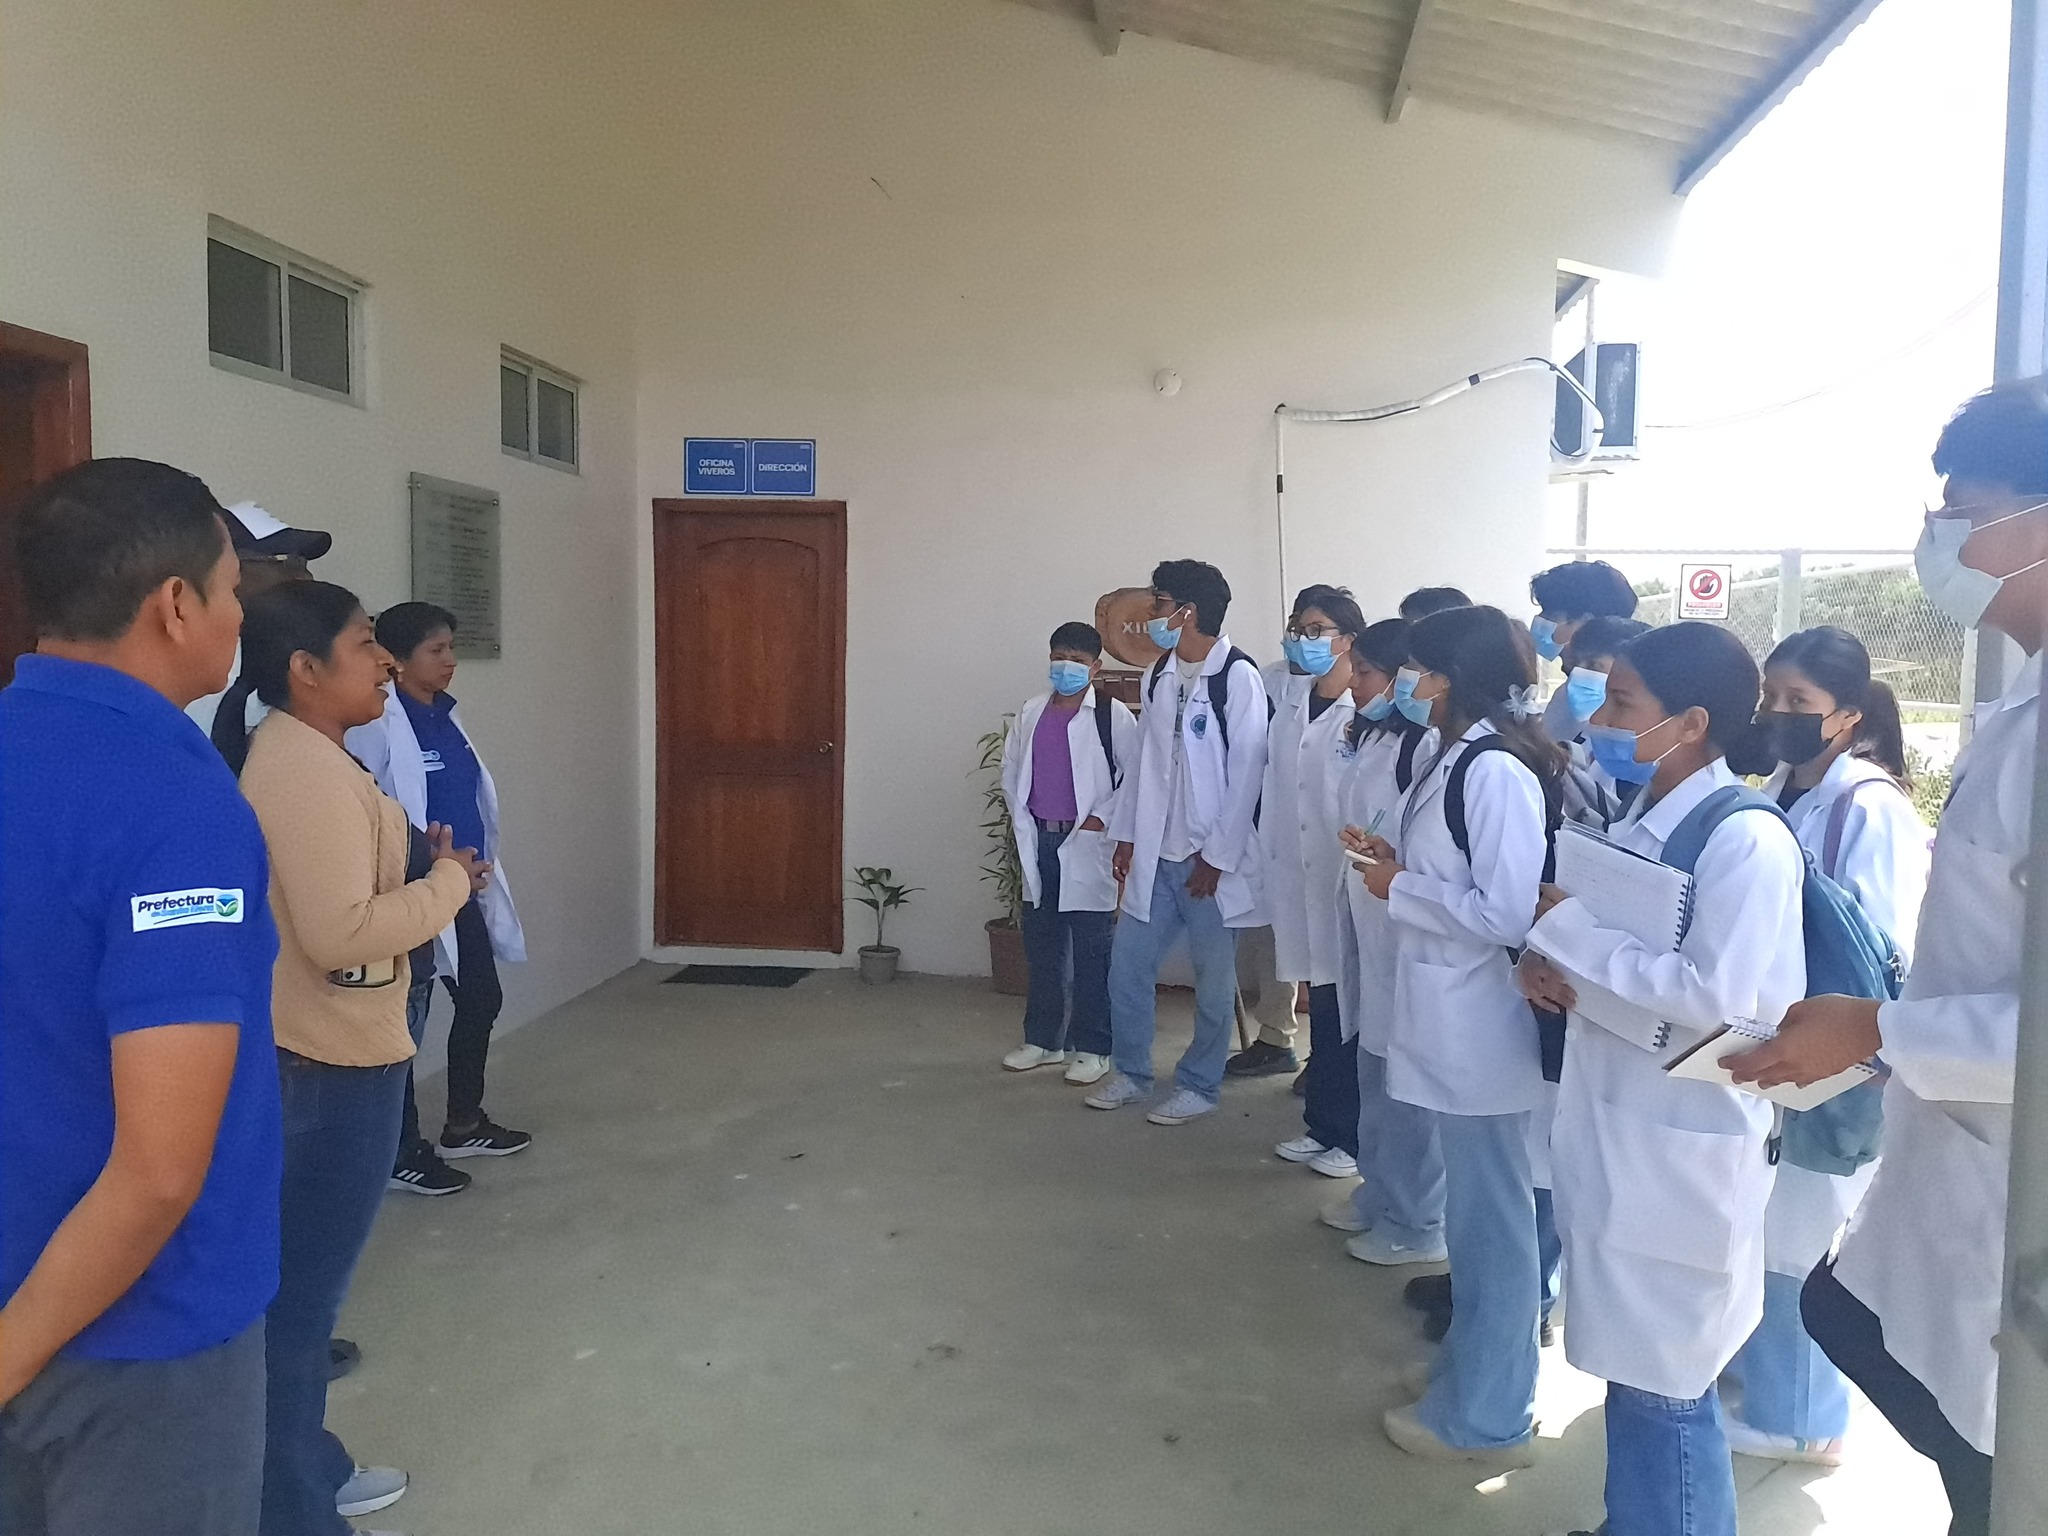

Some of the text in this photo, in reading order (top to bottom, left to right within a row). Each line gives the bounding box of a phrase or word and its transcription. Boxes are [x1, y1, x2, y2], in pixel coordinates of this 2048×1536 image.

[698, 459, 734, 467] OFICINA
[758, 462, 808, 472] DIRECCIÓN
[698, 467, 736, 476] VIVEROS
[138, 895, 214, 913] Prefectura
